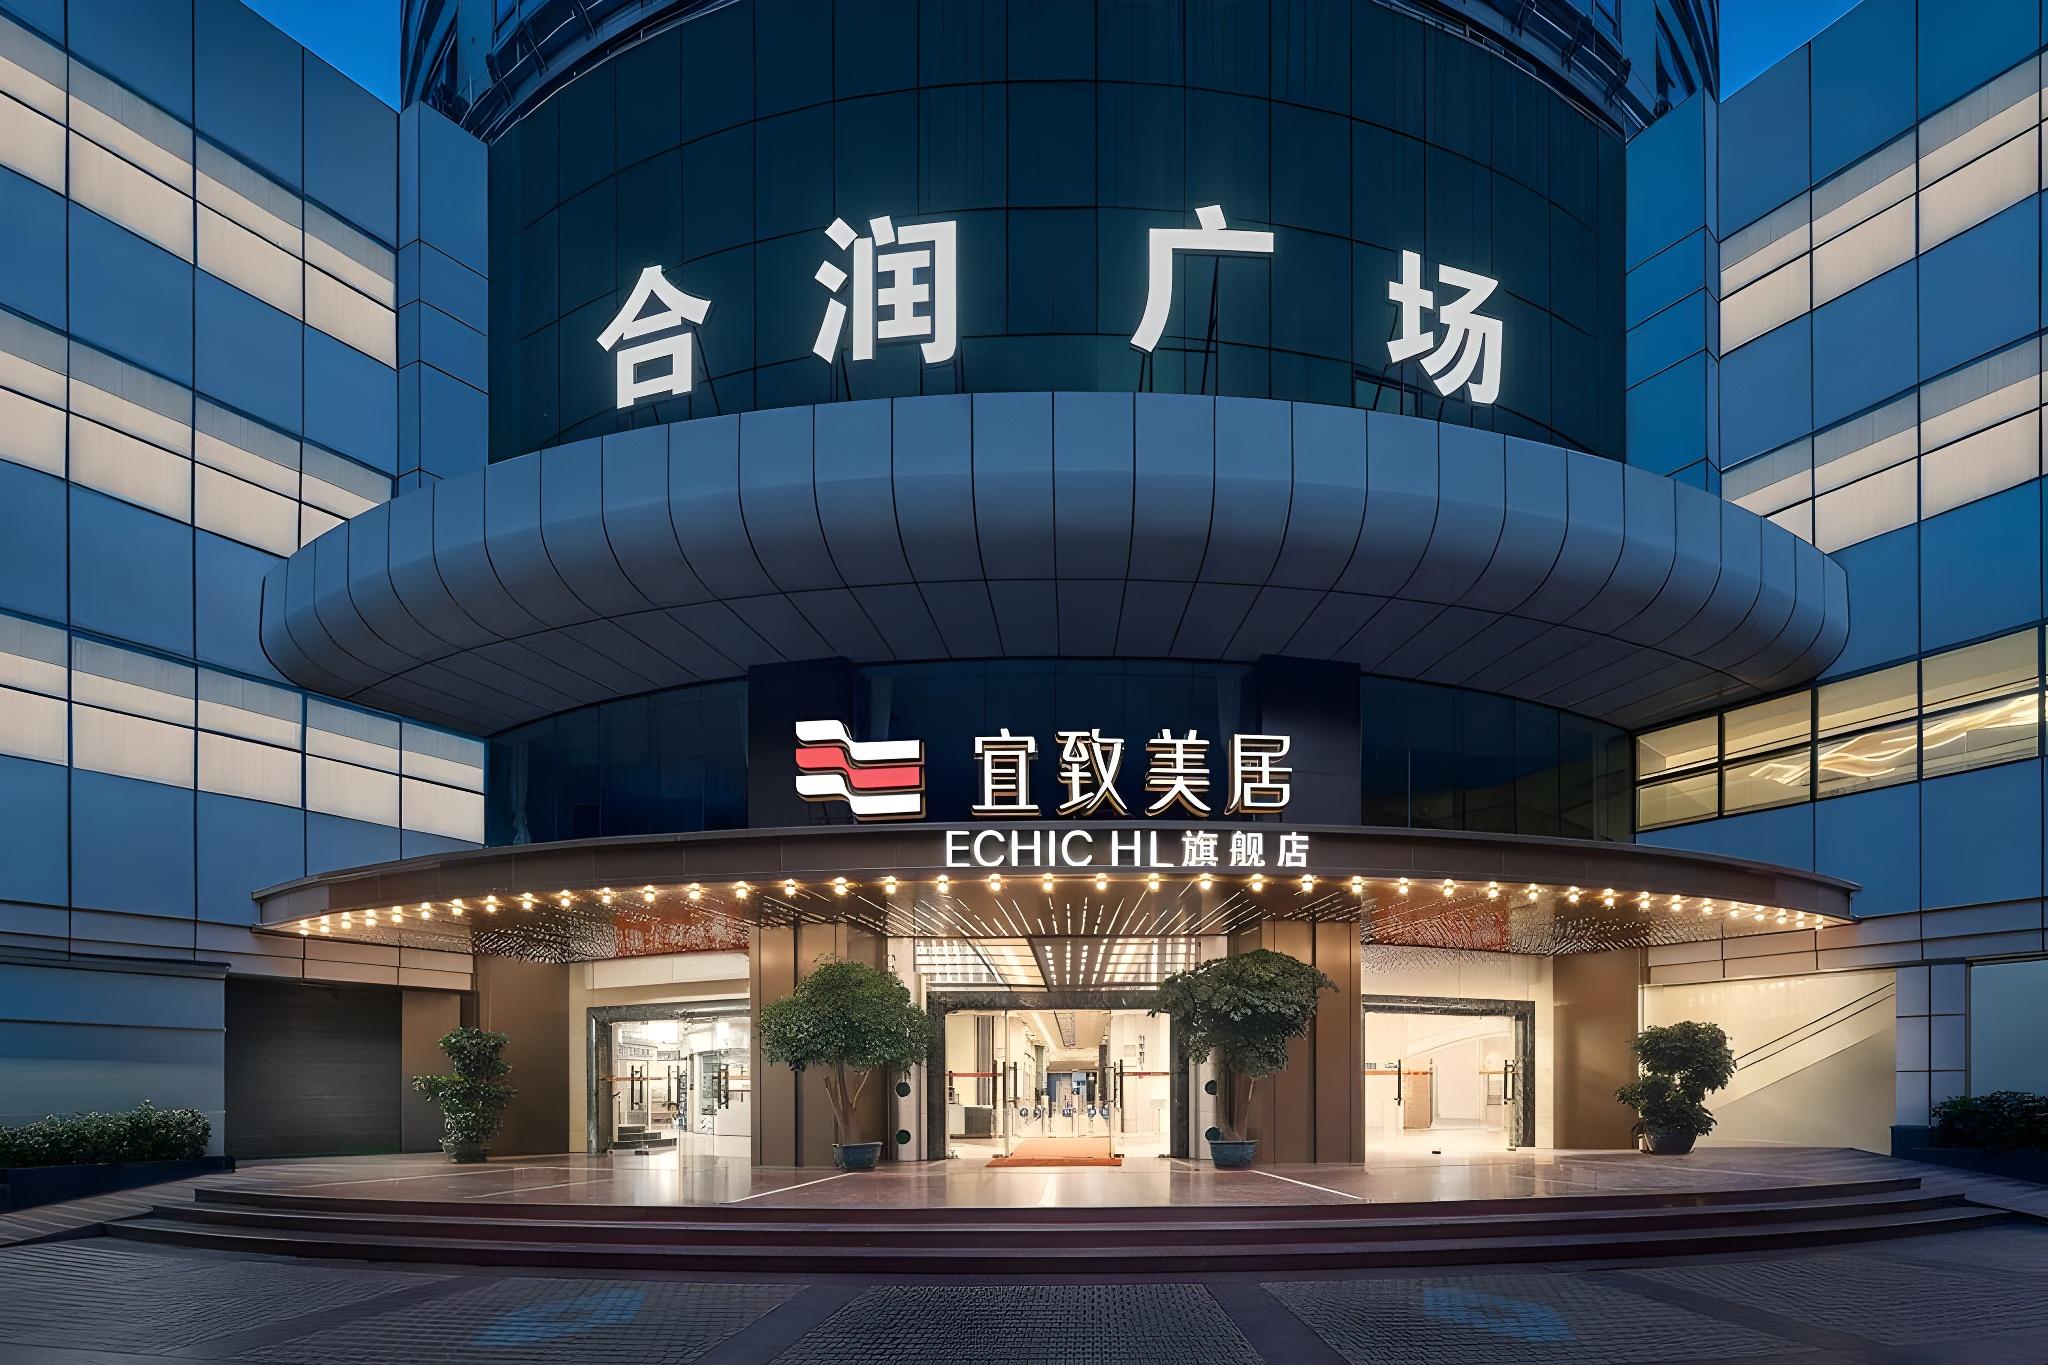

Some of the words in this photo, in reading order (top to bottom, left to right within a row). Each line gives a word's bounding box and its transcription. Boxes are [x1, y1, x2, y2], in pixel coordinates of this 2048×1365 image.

[597, 205, 1504, 408] 合润广场
[972, 728, 1293, 816] 宜致美居
[945, 829, 1093, 868] ECHIC
[1111, 830, 1174, 868] HL
[1181, 830, 1310, 868] 旗舰店
